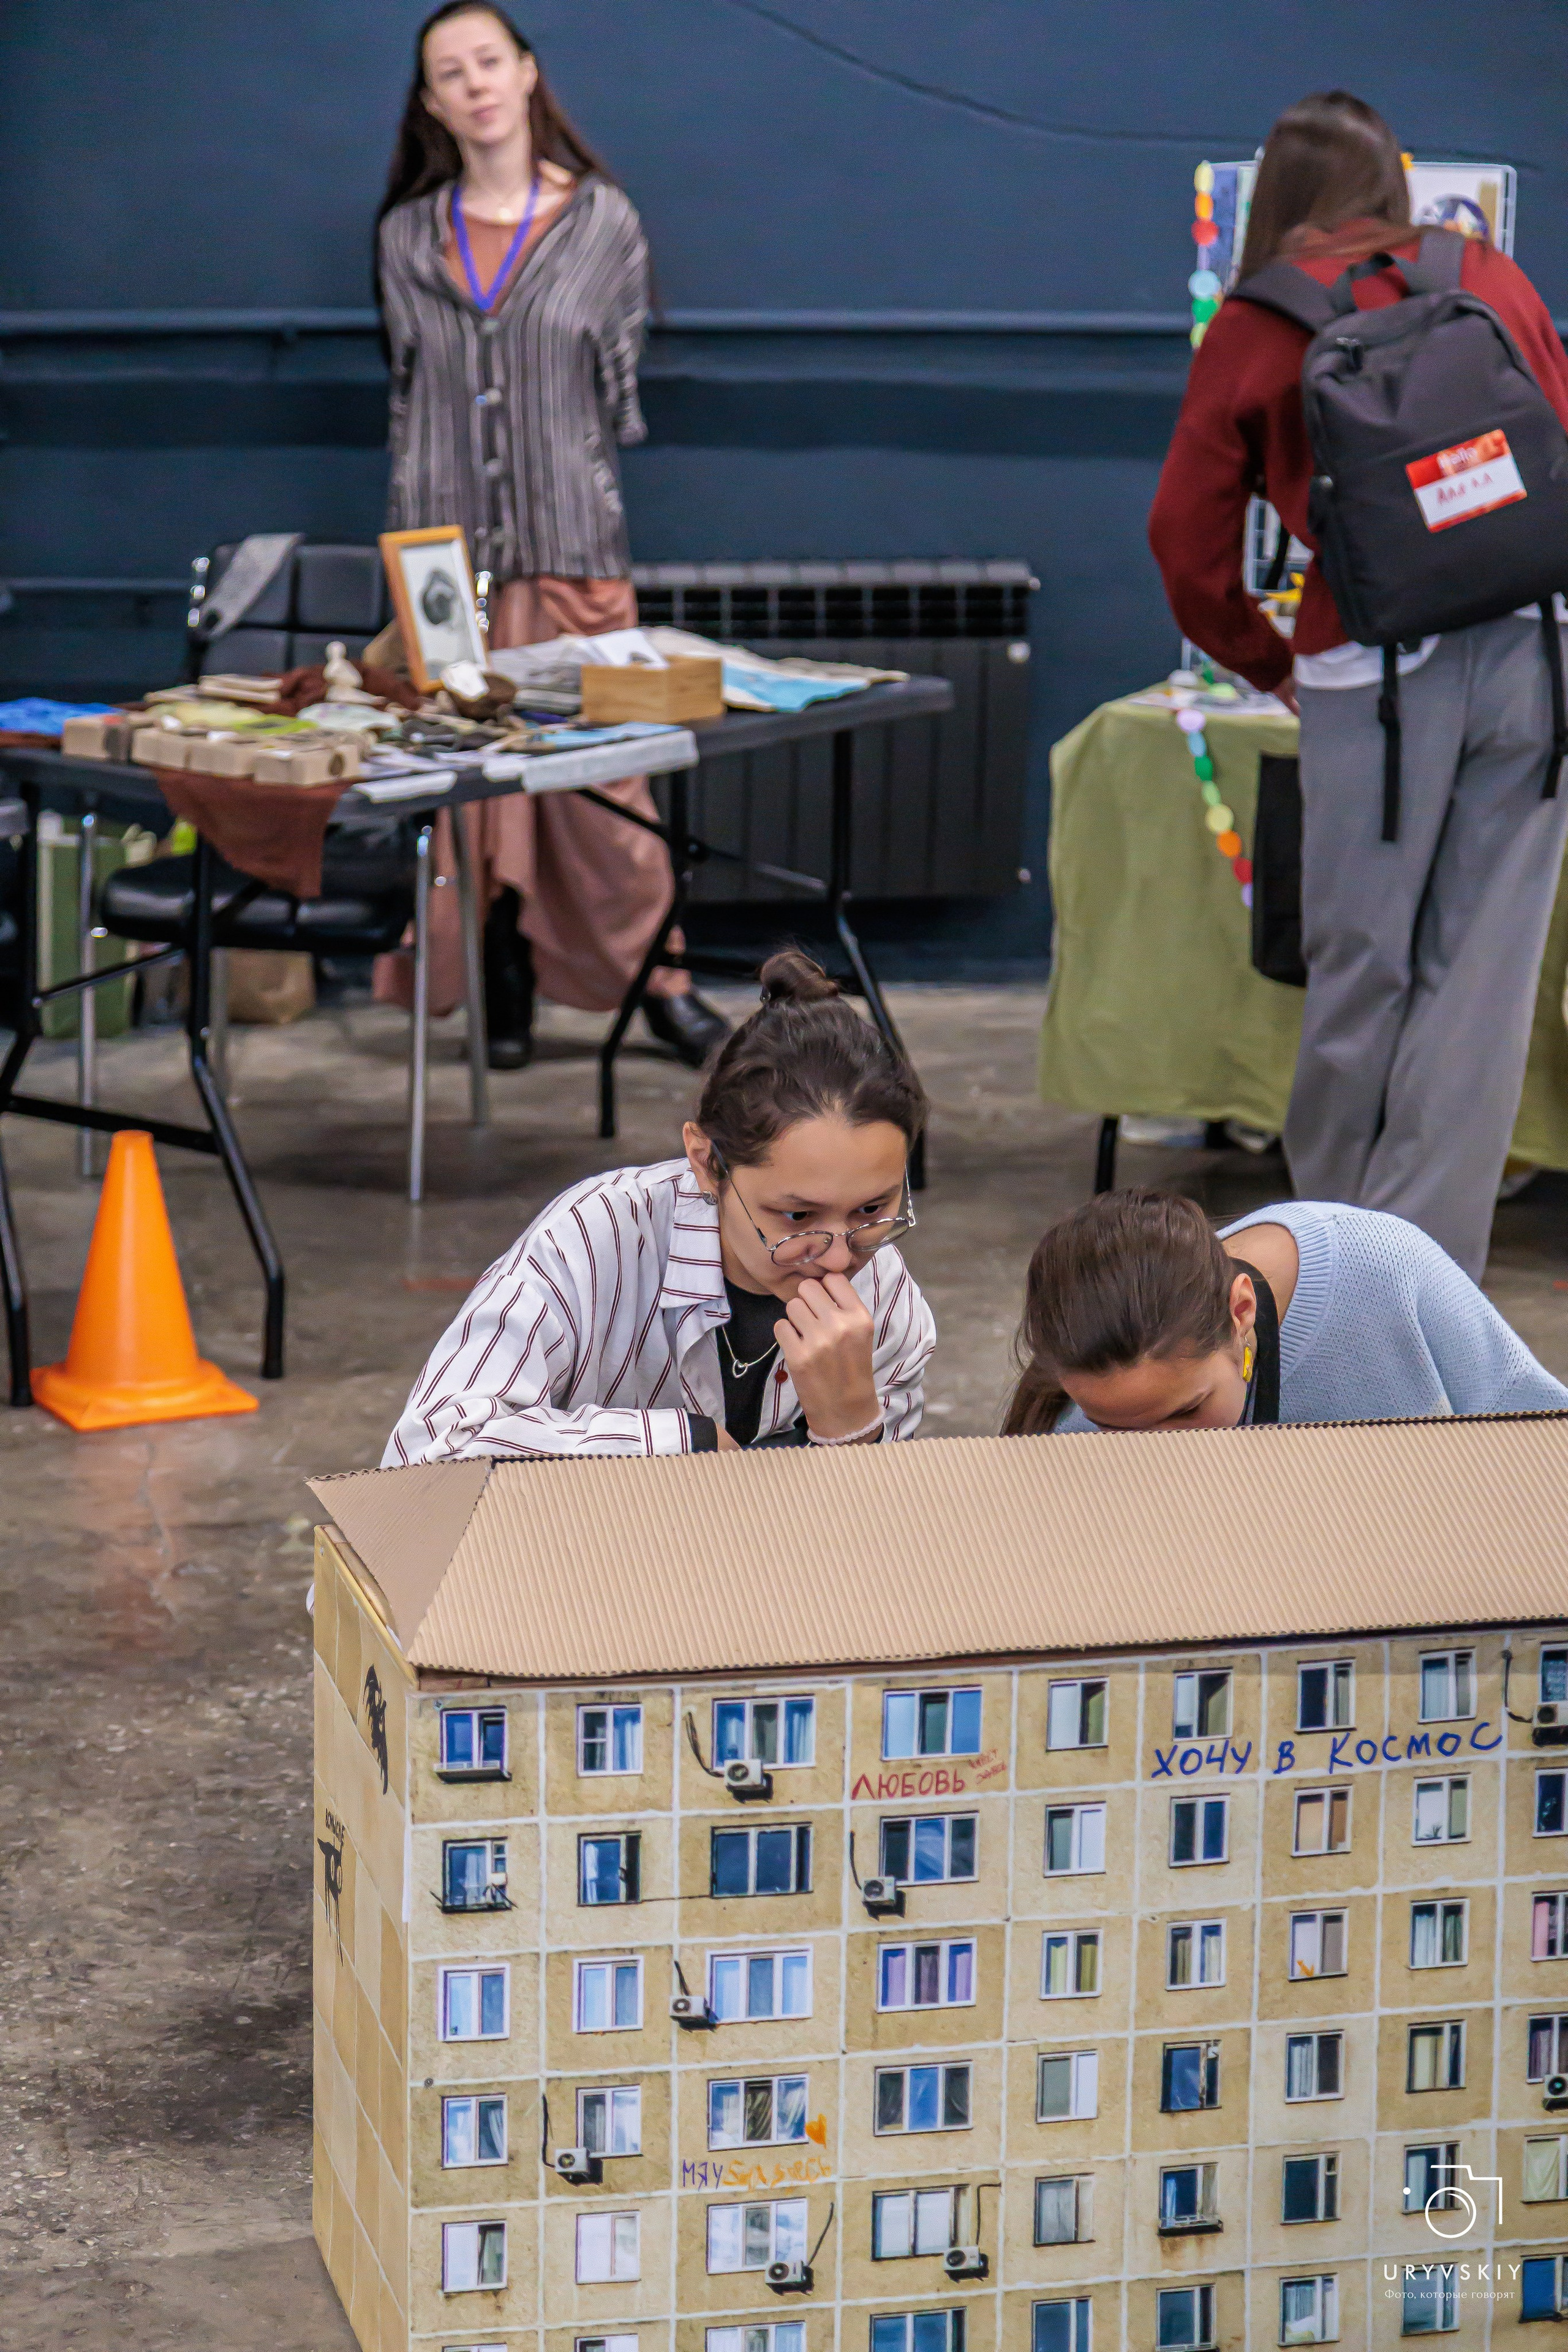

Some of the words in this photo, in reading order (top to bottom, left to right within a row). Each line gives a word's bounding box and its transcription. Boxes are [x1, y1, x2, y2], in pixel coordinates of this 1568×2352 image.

[1150, 1740, 1253, 1779] ХОЧУ
[1273, 1740, 1295, 1775] В
[1329, 1722, 1503, 1774] КОСМОС
[851, 1770, 966, 1800] ЛЮБОВЬ
